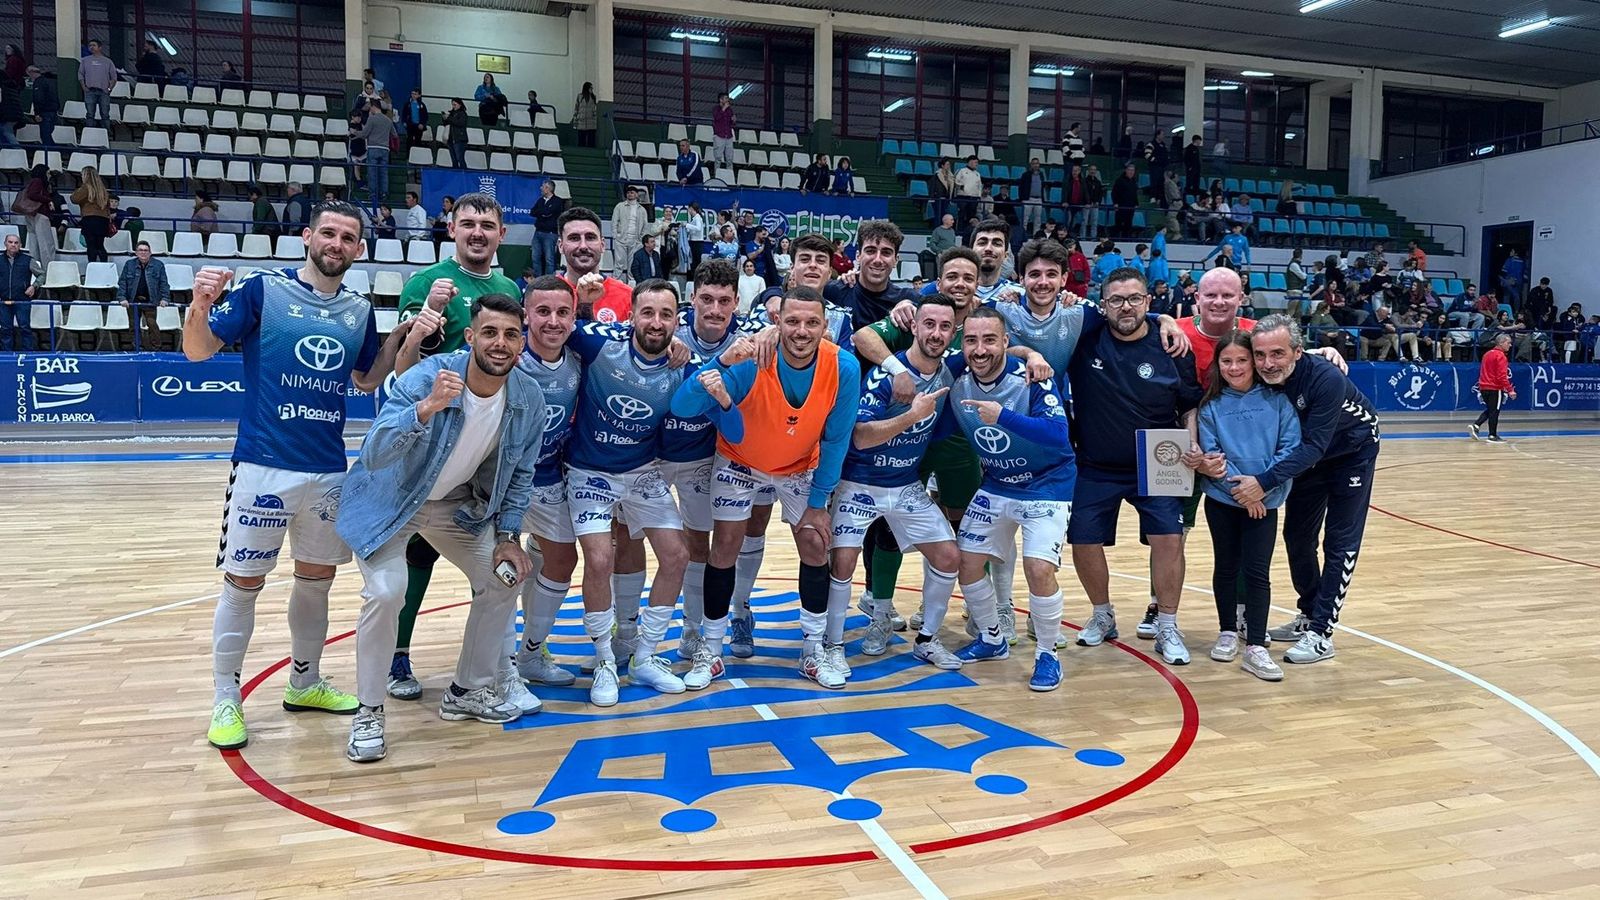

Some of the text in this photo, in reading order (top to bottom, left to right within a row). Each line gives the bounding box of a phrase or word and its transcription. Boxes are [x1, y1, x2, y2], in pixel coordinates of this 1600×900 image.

[35, 357, 80, 373] BAR
[1533, 365, 1562, 383] AL
[185, 381, 246, 392] LEX
[1576, 383, 1585, 391] 79
[1585, 383, 1593, 391] 14
[16, 373, 27, 422] RINCON
[1534, 388, 1561, 407] LO
[31, 413, 96, 422] DE LA BARCA
[1155, 478, 1183, 486] GODINO
[965, 509, 992, 524] AMMA
